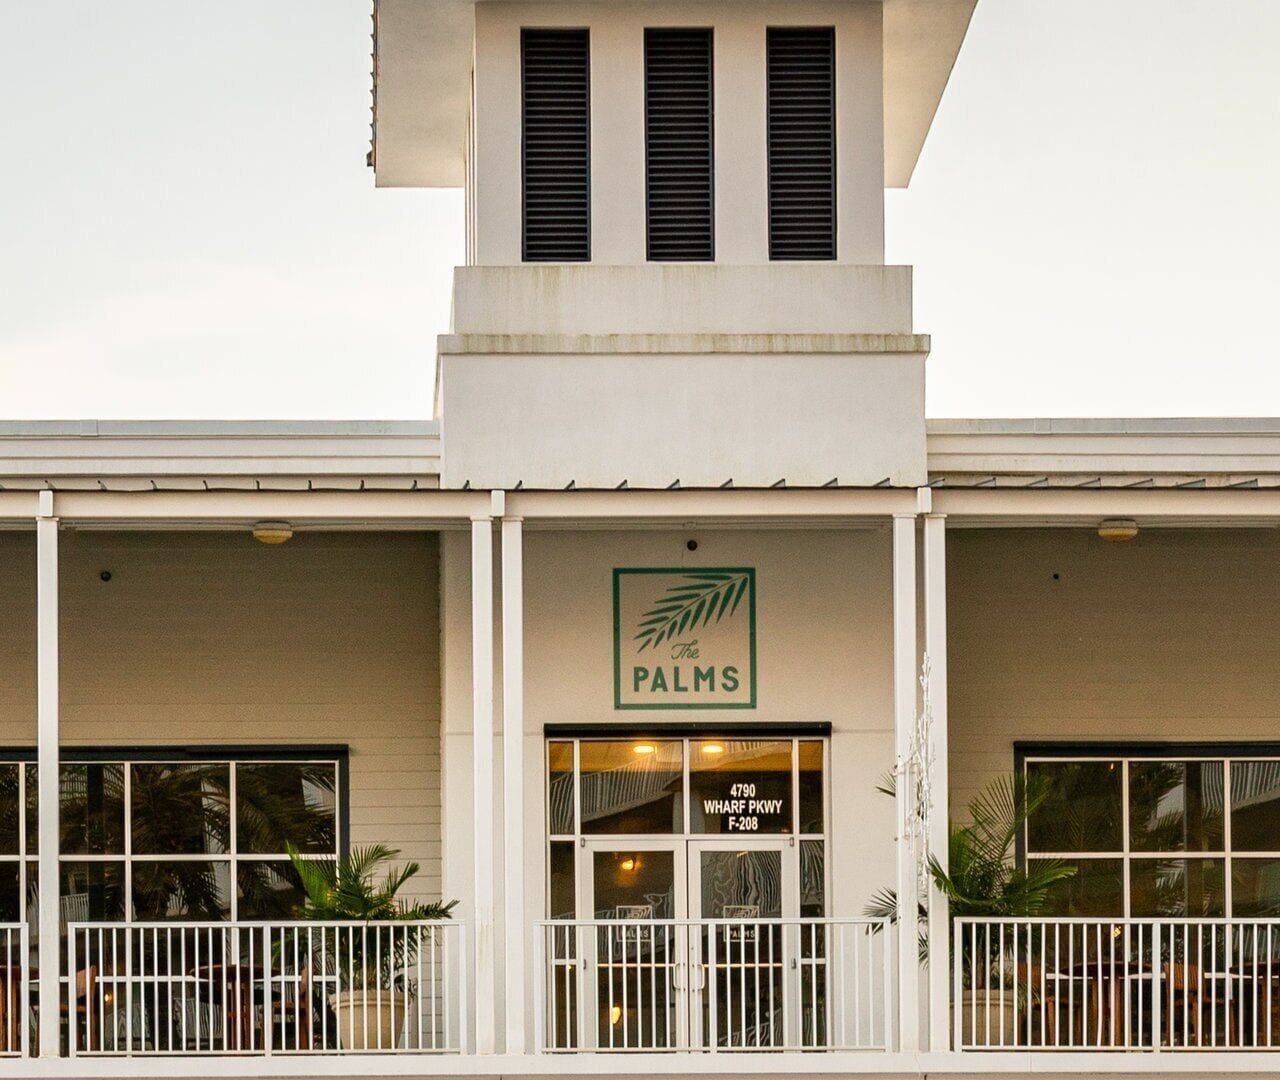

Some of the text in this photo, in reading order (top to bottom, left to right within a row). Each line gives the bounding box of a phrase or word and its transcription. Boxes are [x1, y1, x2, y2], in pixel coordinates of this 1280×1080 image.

[671, 639, 700, 660] The
[633, 665, 740, 692] PALMS
[730, 783, 756, 798] 4790
[704, 799, 783, 814] WHARF PKWY
[728, 816, 759, 831] F-208
